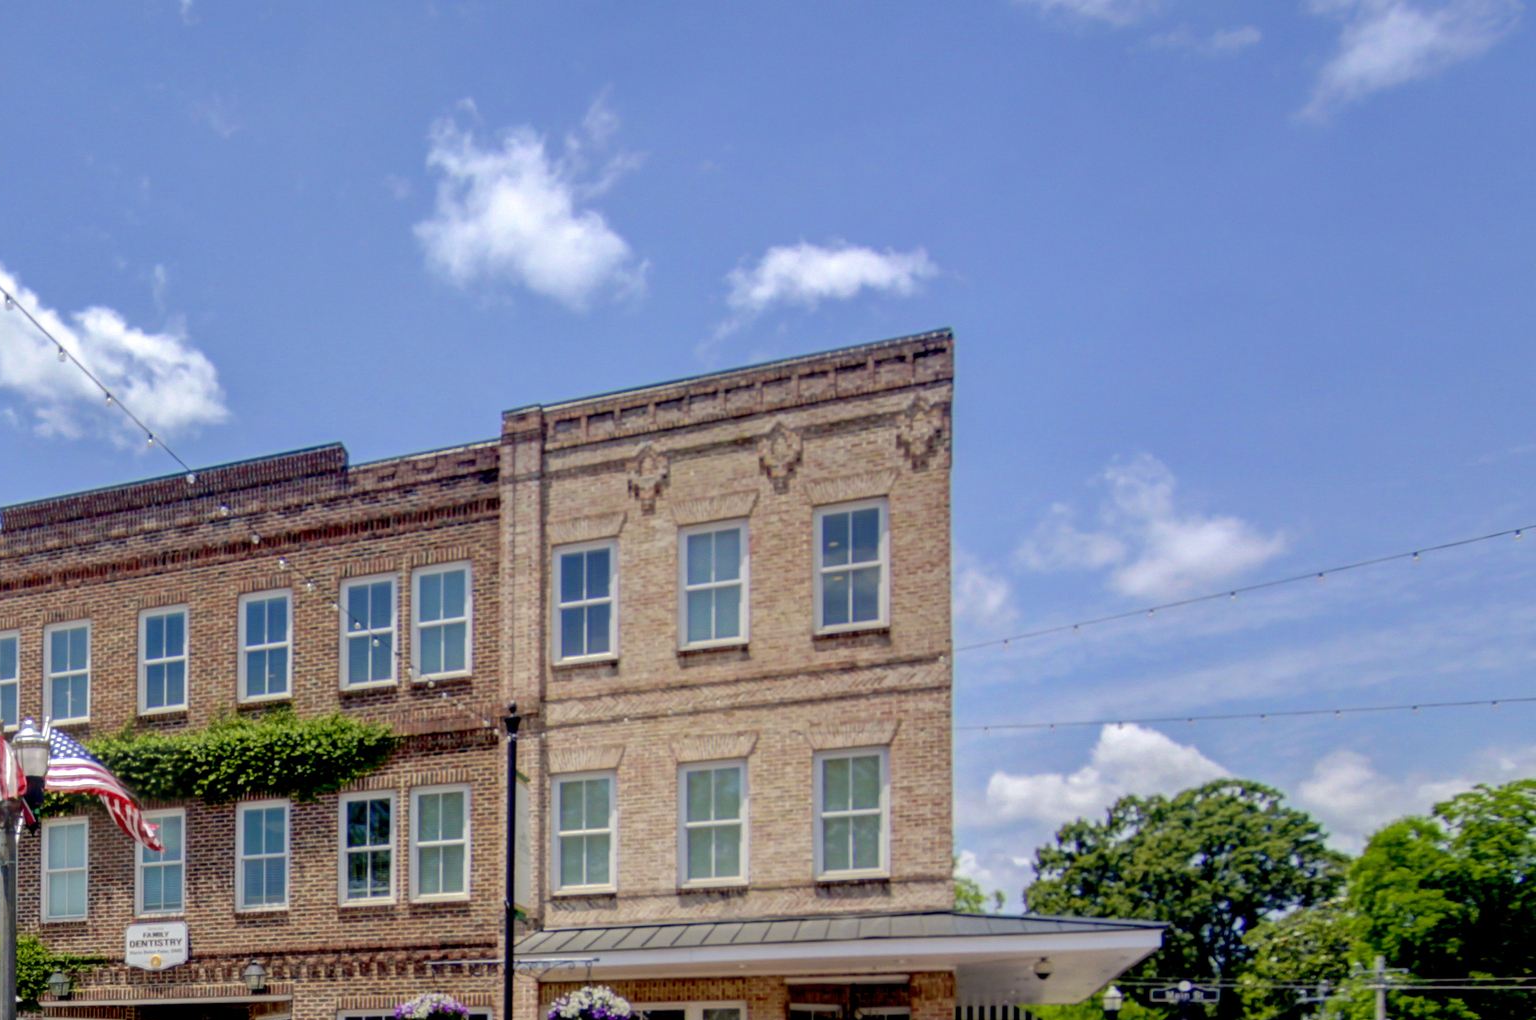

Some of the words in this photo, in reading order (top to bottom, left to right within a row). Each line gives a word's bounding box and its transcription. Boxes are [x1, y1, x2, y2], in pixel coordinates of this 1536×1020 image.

[129, 938, 183, 948] DENTISTRY
[1165, 990, 1191, 1000] Main
[1192, 990, 1204, 1000] St
